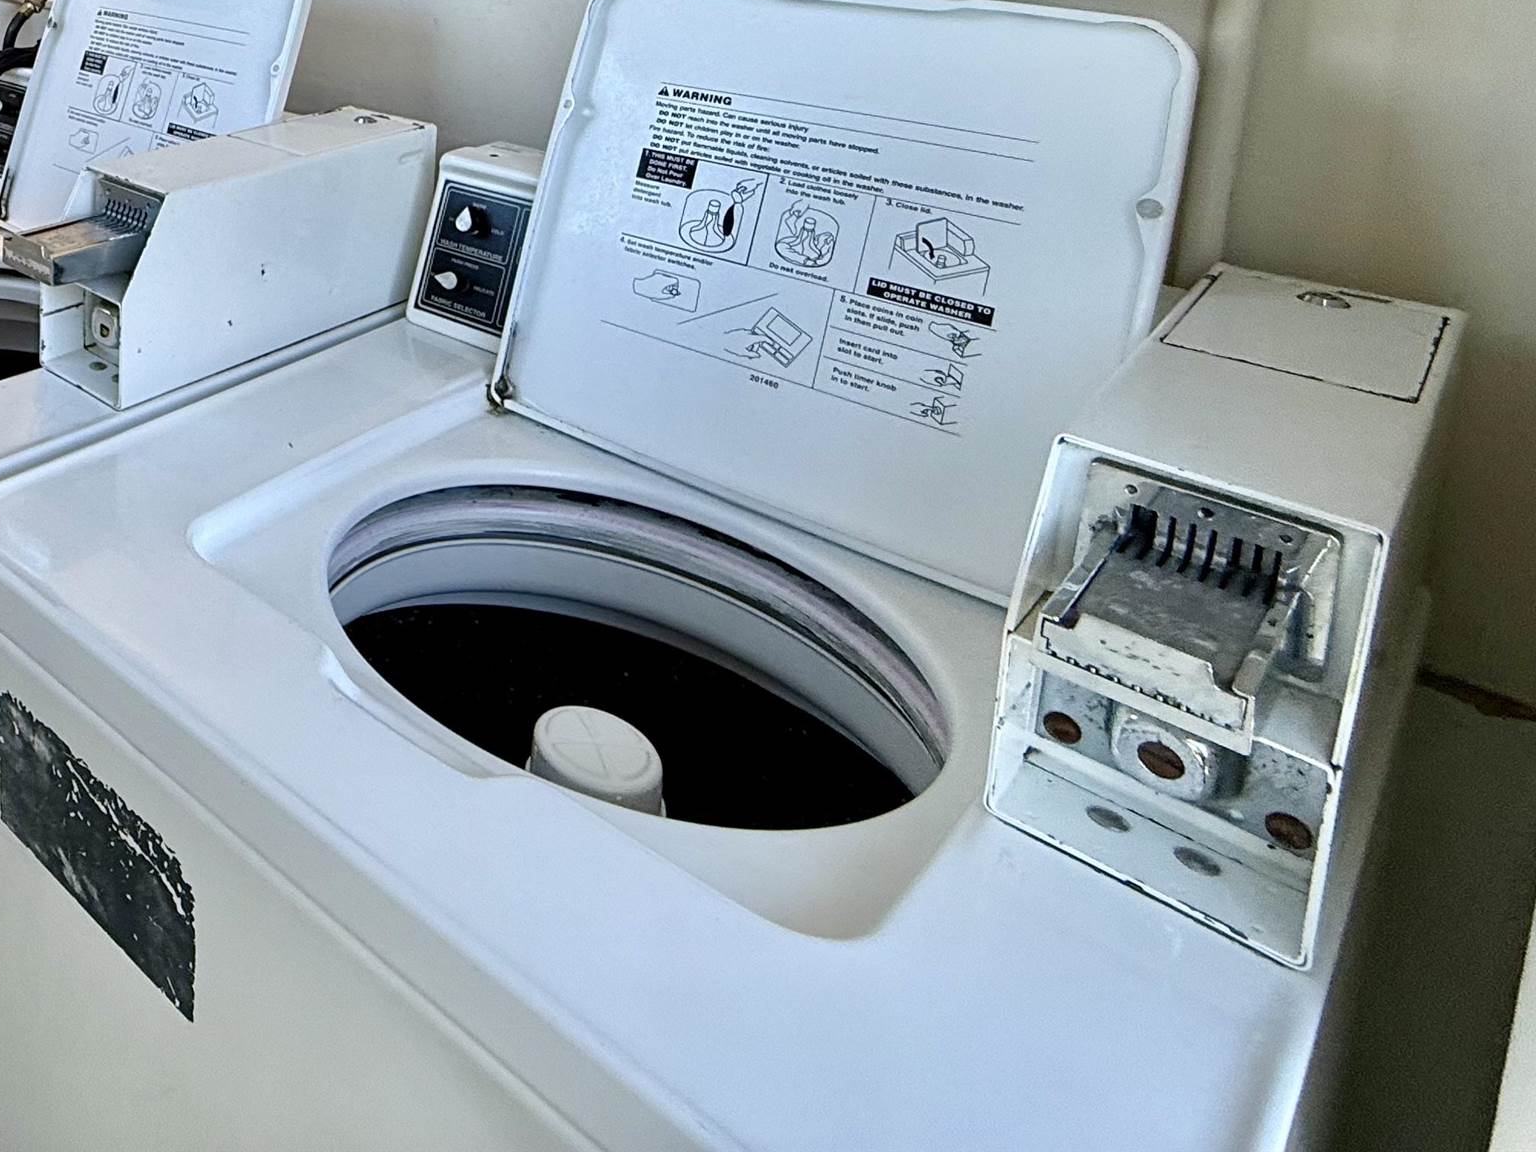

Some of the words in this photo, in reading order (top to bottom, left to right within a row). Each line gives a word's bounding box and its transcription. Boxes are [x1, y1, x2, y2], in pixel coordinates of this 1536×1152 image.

[672, 88, 733, 106] WARNING
[655, 100, 679, 111] Moving
[679, 105, 697, 114] parts
[697, 107, 721, 117] hazard.
[722, 111, 737, 120] Can
[737, 115, 759, 124] cause
[759, 119, 787, 129] serious
[787, 123, 810, 134] injury
[655, 117, 667, 125] DO
[668, 119, 684, 128] NOT
[693, 125, 719, 134] children
[719, 130, 734, 138] play
[762, 136, 773, 144] the
[774, 140, 800, 149] washer.
[658, 109, 670, 117] DO
[670, 112, 687, 120] NOT
[687, 115, 705, 123] reach
[705, 118, 719, 126] into
[719, 120, 730, 128] the
[731, 123, 755, 132] washer
[781, 132, 808, 143] moving
[808, 137, 827, 145] parts
[828, 139, 847, 149] have
[847, 143, 880, 155] stopped.
[779, 177, 787, 185] 2.
[787, 179, 806, 189] Load
[806, 184, 832, 194] clothes
[832, 189, 859, 201] loosely
[785, 187, 799, 196] into
[800, 190, 812, 198] the
[812, 194, 832, 202] wash
[832, 197, 846, 206] tub.
[885, 198, 894, 207] 3.
[895, 201, 919, 212] Close
[920, 206, 932, 215] lid.
[458, 242, 504, 262] TEMPERATURE
[871, 279, 888, 289] LID
[889, 284, 917, 296] MUST
[918, 291, 932, 300] BE
[934, 295, 975, 311] CLOSED
[977, 305, 991, 315] TO
[883, 291, 927, 308] OPERATE
[929, 302, 972, 319] WASHER
[453, 302, 486, 318] SELECTOR
[839, 294, 848, 304] 5.
[848, 298, 871, 310] Place
[871, 305, 894, 316] coins
[895, 311, 904, 319] in
[904, 314, 924, 324] coin
[846, 307, 867, 318] slots.
[876, 315, 897, 327] slide,
[898, 322, 920, 332] push
[844, 314, 853, 322] in
[853, 317, 872, 328] then
[872, 323, 889, 332] pull
[889, 327, 905, 337] out.
[837, 346, 852, 356] slot
[853, 350, 862, 358] to
[862, 354, 884, 365] start.
[839, 337, 862, 350] Insert
[862, 345, 881, 355] card
[881, 350, 899, 360] into
[830, 374, 839, 382] in
[839, 377, 849, 385] to
[849, 381, 870, 392] start.
[832, 366, 853, 379] Push
[853, 373, 875, 385] timer
[875, 380, 897, 392] knob
